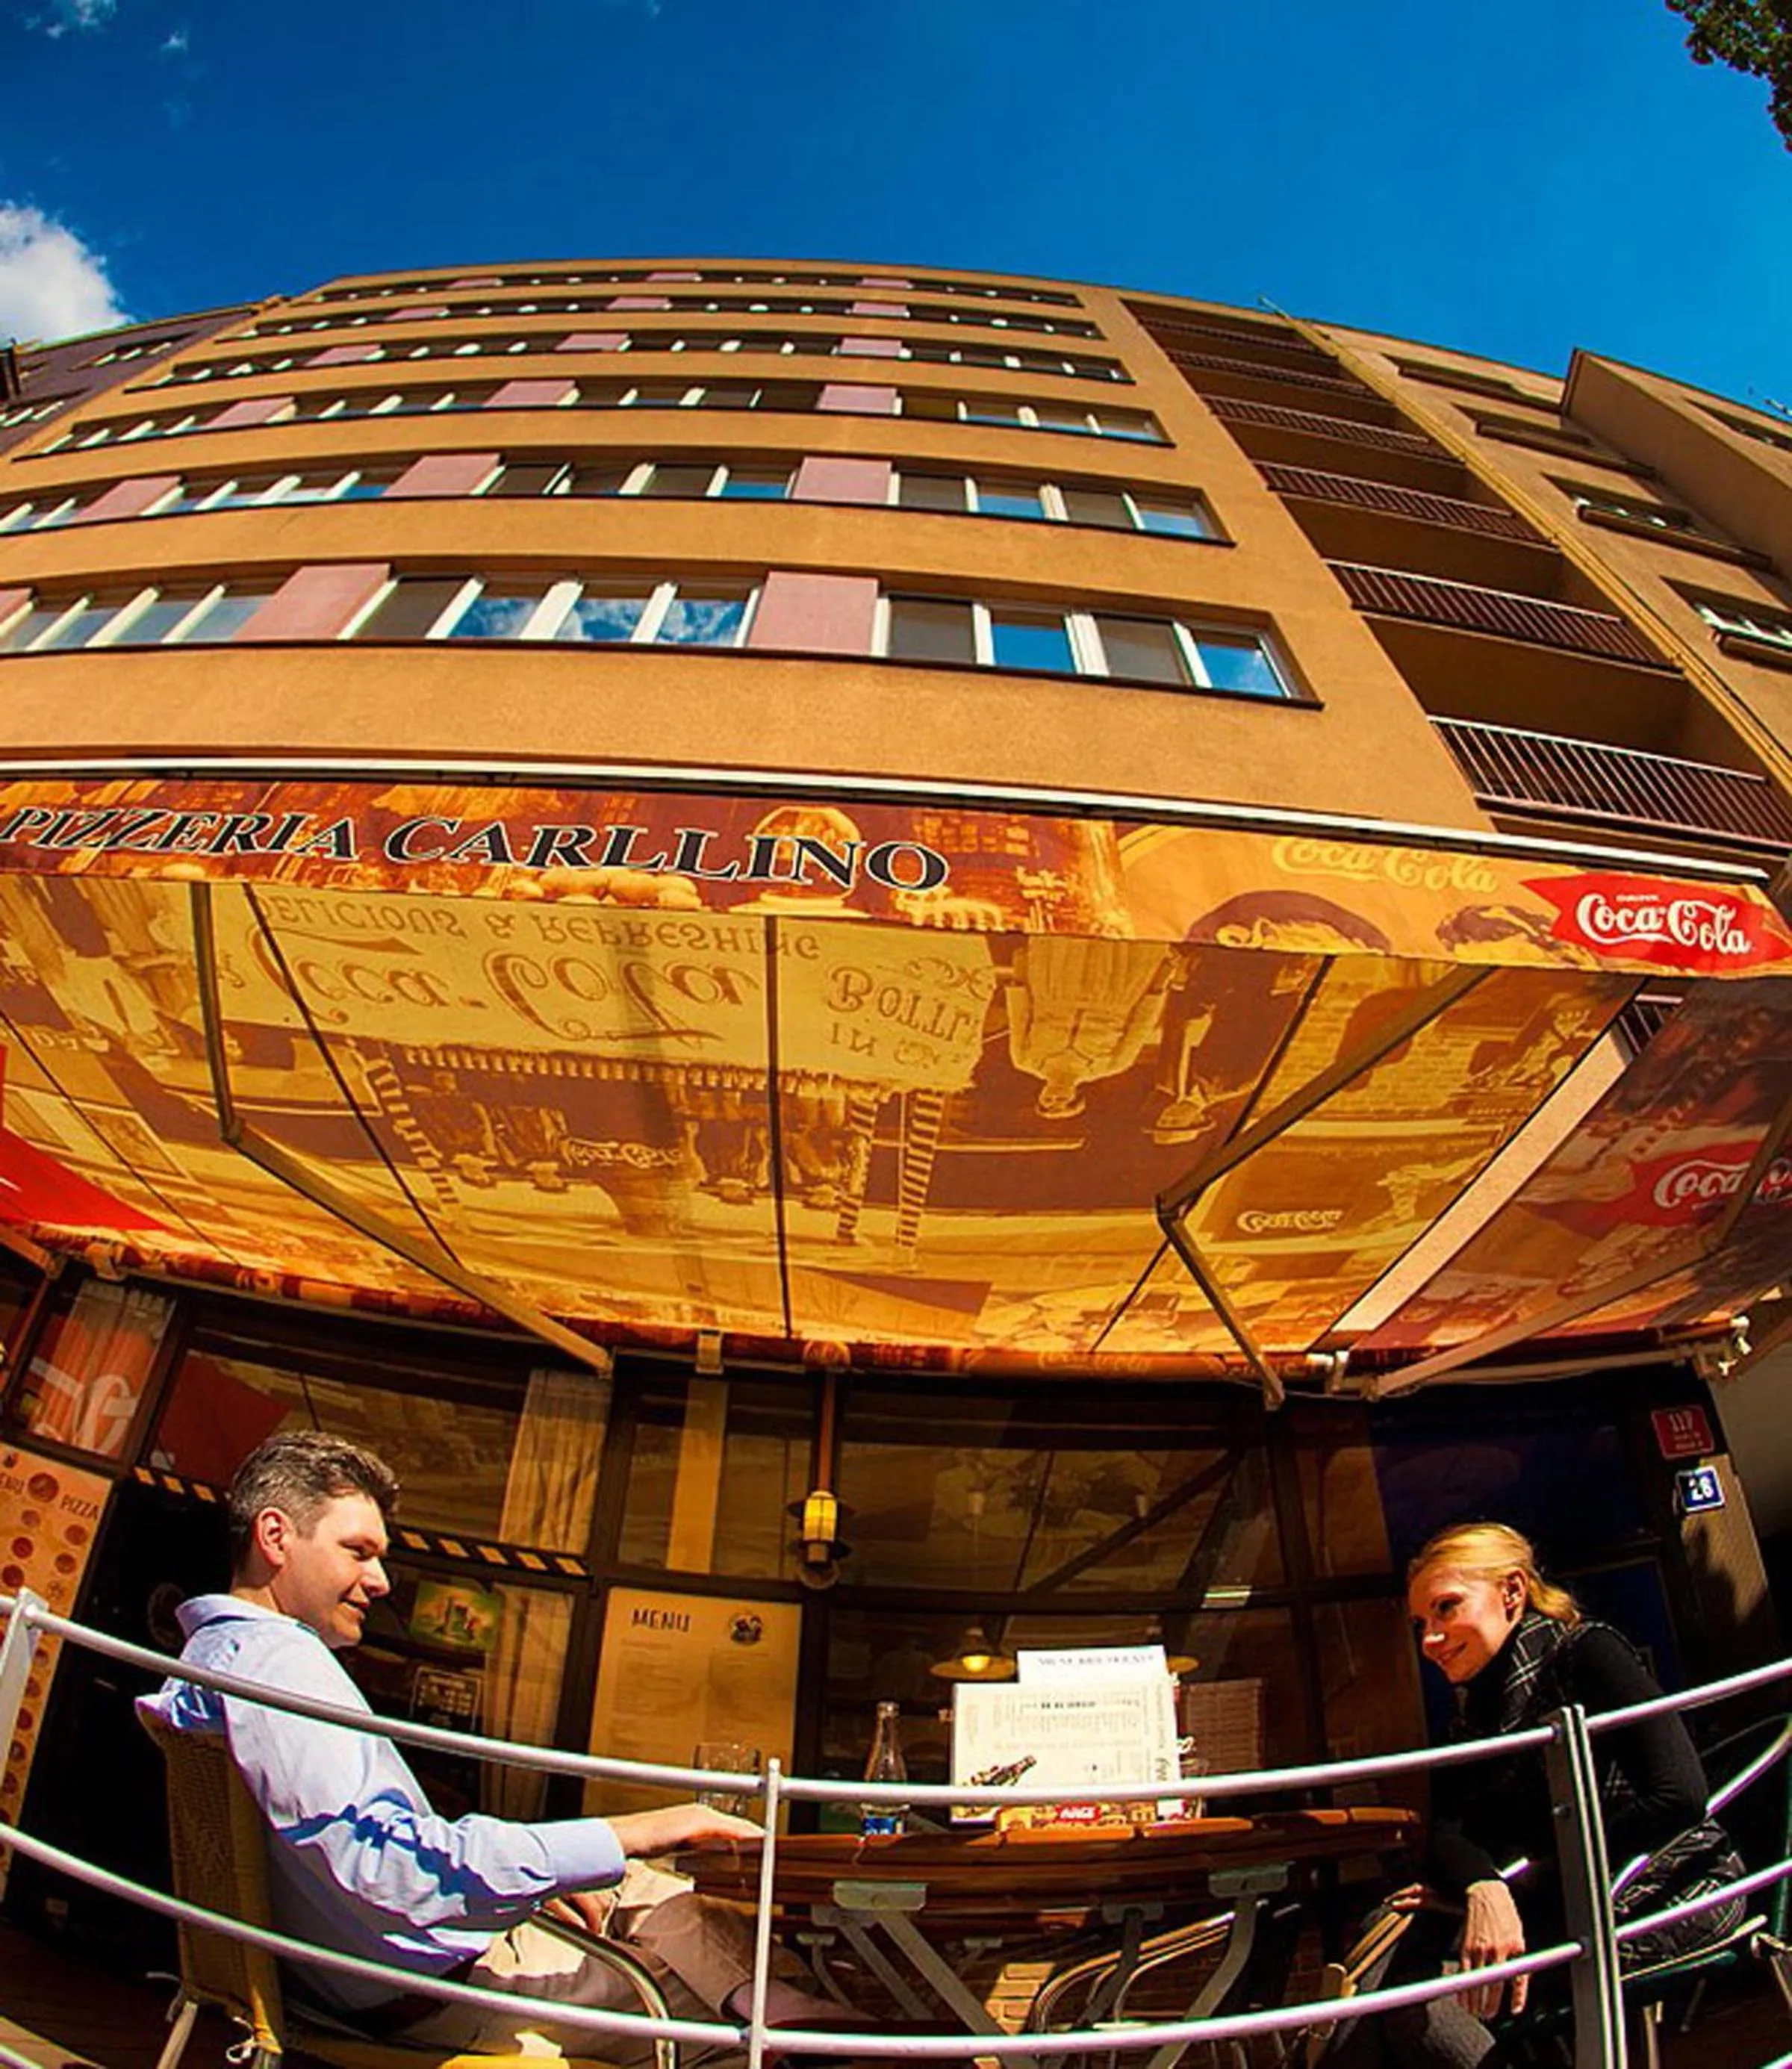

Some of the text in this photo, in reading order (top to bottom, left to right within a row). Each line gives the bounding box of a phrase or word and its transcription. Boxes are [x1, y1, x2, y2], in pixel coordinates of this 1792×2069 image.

[0, 806, 950, 892] PIZZERIA CARLLINO
[632, 1608, 691, 1633] MENU
